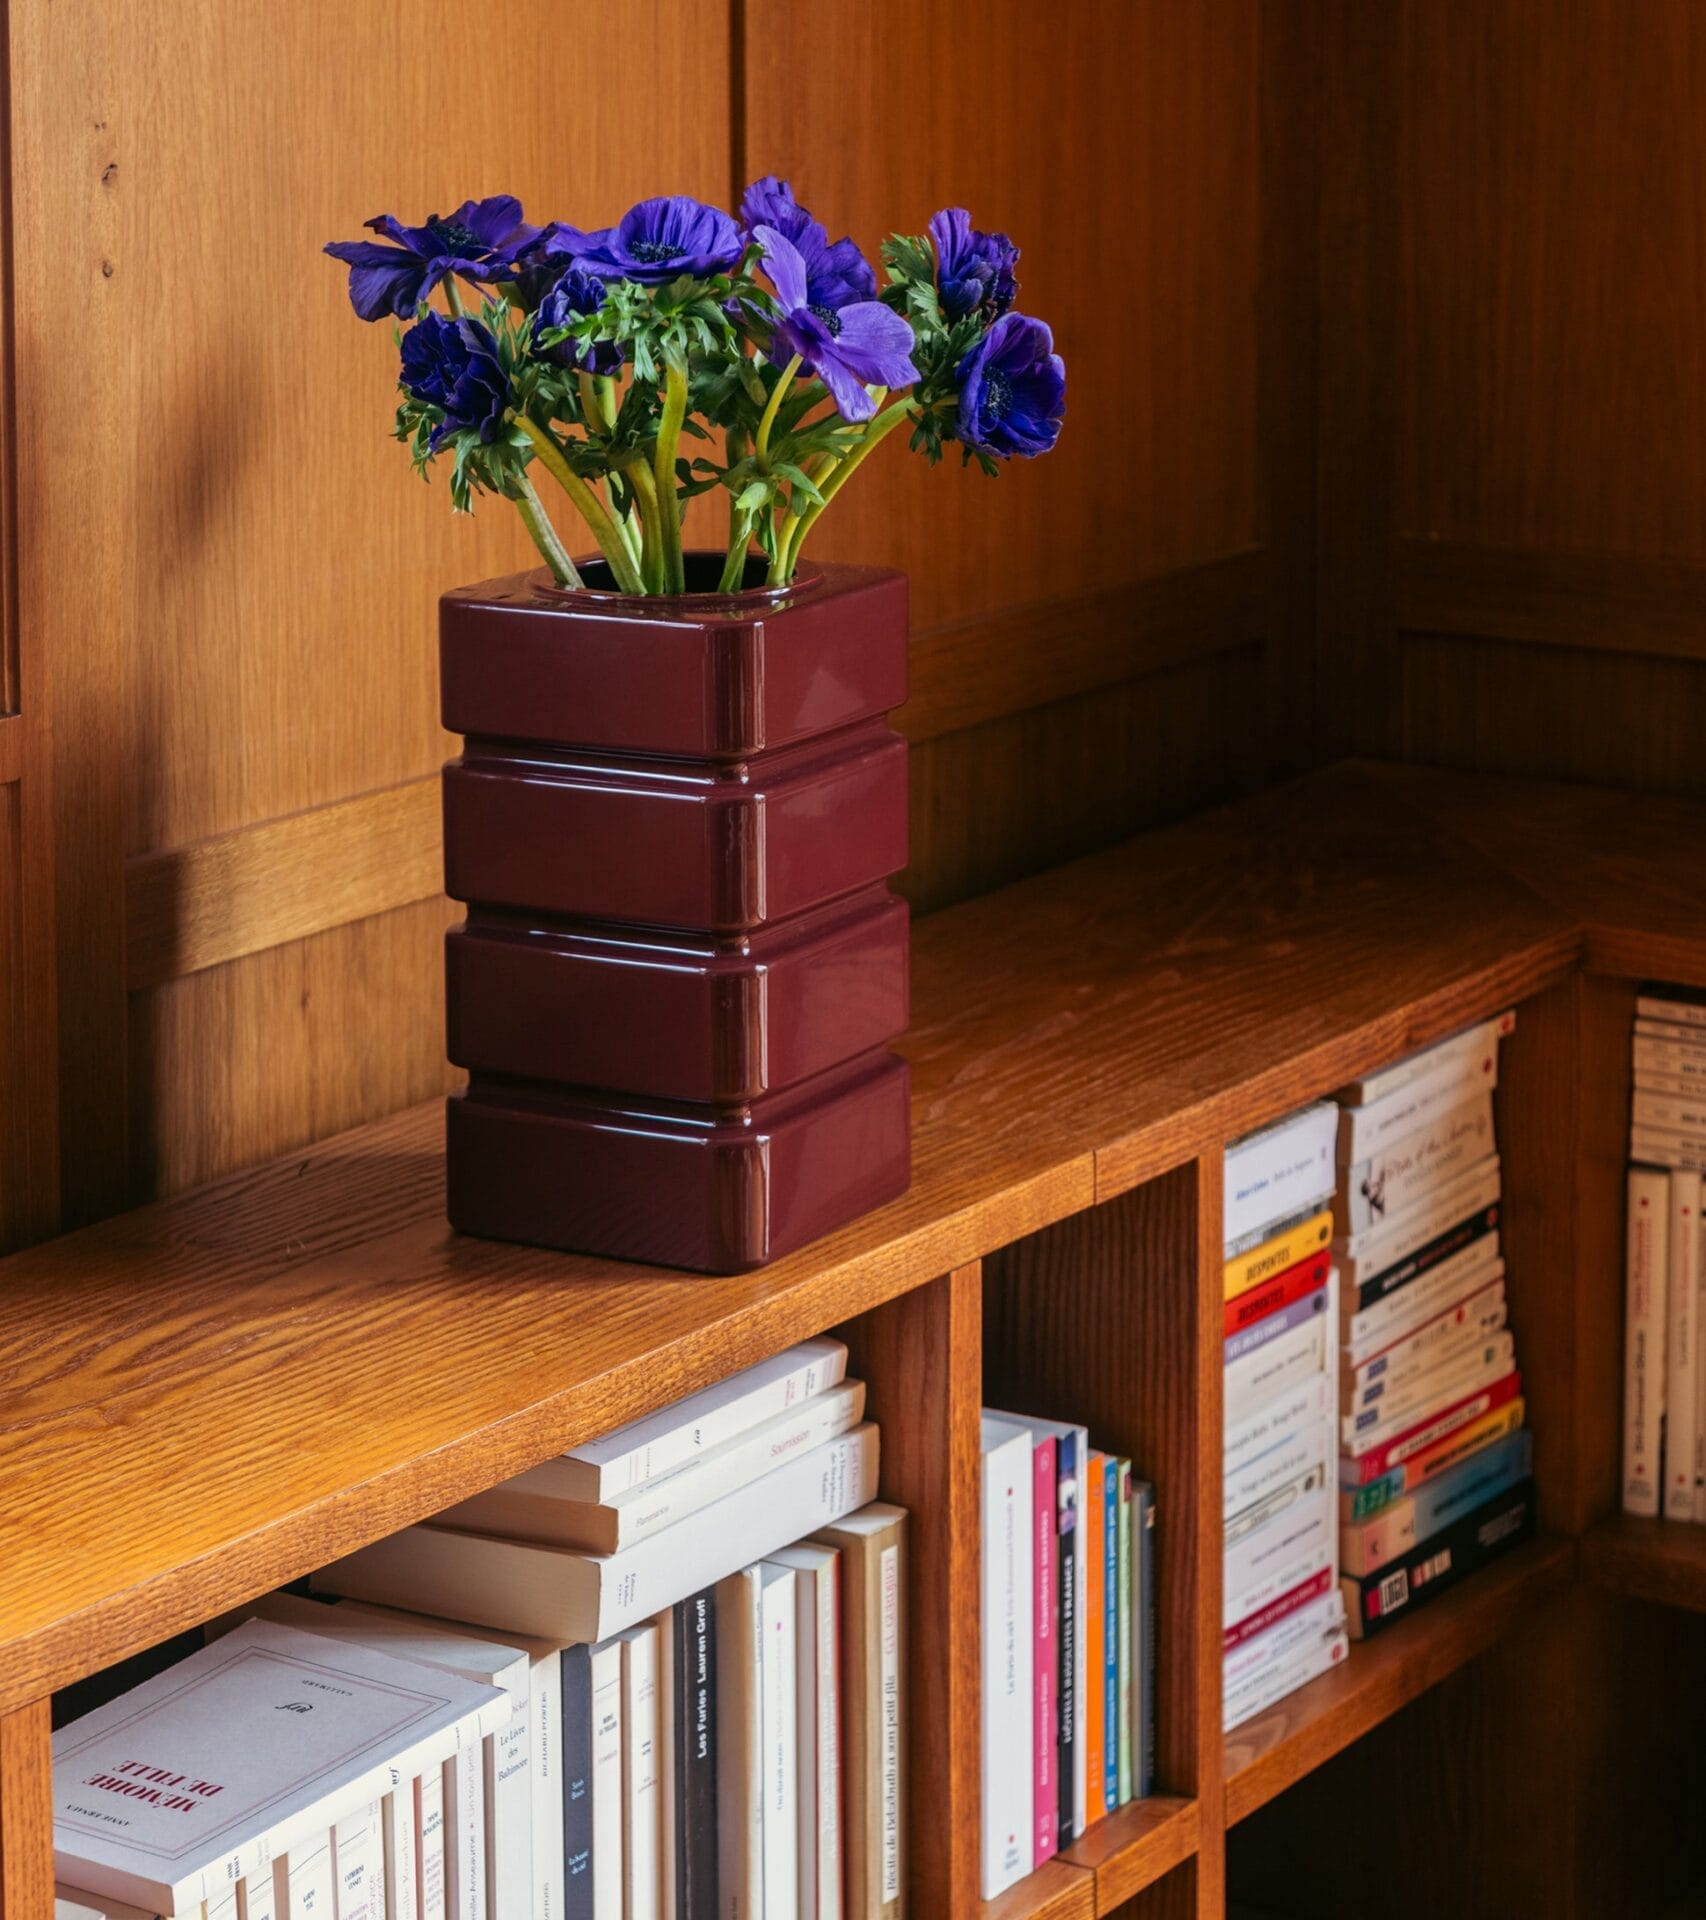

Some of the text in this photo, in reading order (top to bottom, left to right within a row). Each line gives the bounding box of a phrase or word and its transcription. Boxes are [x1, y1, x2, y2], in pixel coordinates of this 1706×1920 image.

[1245, 1248, 1290, 1282] DESPENTES
[1061, 1554, 1074, 1743] HÔTELS INSOLITES FRANCE
[301, 1679, 354, 1697] GALLIMARD
[696, 1598, 708, 1758] Les Furies Lauren Groff
[885, 1674, 898, 1727] petit-fils
[500, 1725, 526, 1747] Le Livre
[887, 1731, 896, 1752] son
[507, 1746, 519, 1759] des
[112, 1759, 225, 1798] DE FILLE
[388, 1766, 400, 1786] nrf
[498, 1758, 529, 1782] Baltimore
[81, 1772, 204, 1813] MÉMOIRE
[65, 1802, 132, 1828] ANNIE ERNAUX
[885, 1835, 897, 1851] de
[886, 1853, 897, 1890] Récits
